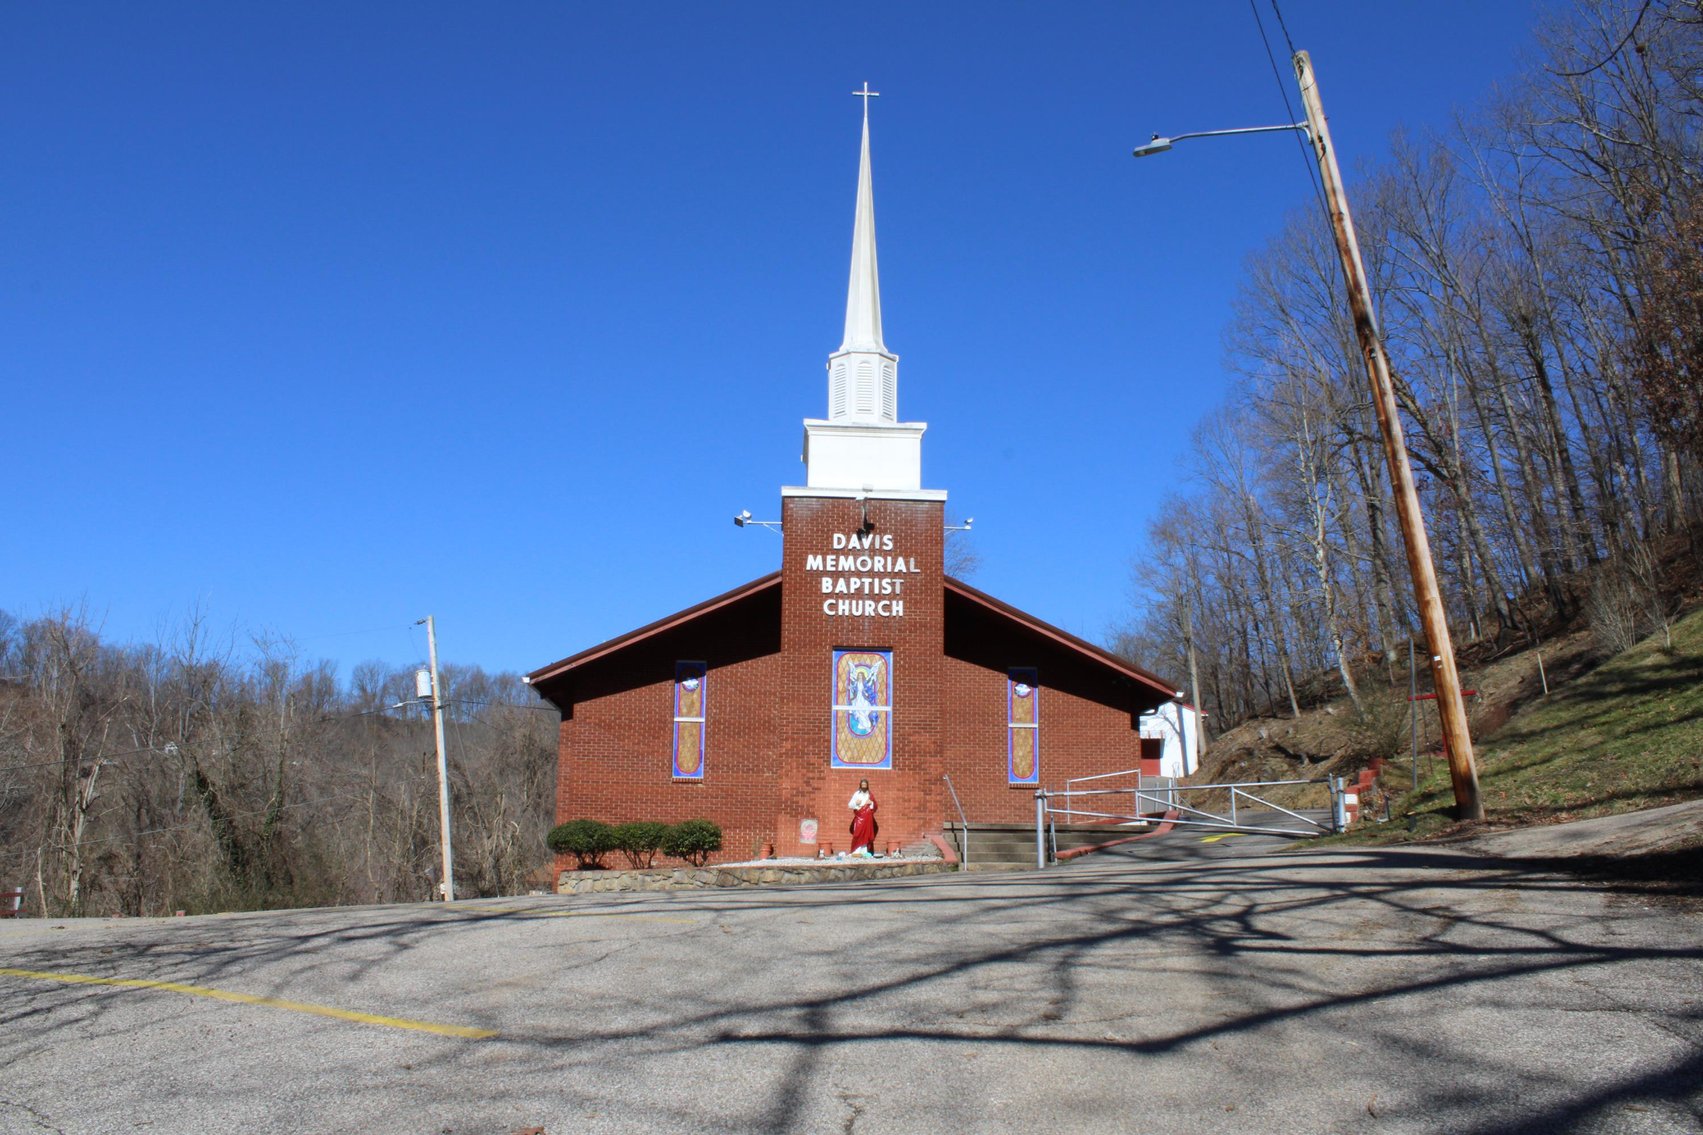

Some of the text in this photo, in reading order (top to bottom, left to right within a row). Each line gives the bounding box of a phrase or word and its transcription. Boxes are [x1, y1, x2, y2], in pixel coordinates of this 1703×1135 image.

[833, 533, 893, 551] DAVIS
[806, 555, 921, 573] MEMORIAL
[821, 577, 904, 595] BAPTIST
[823, 599, 904, 617] CHURCH
